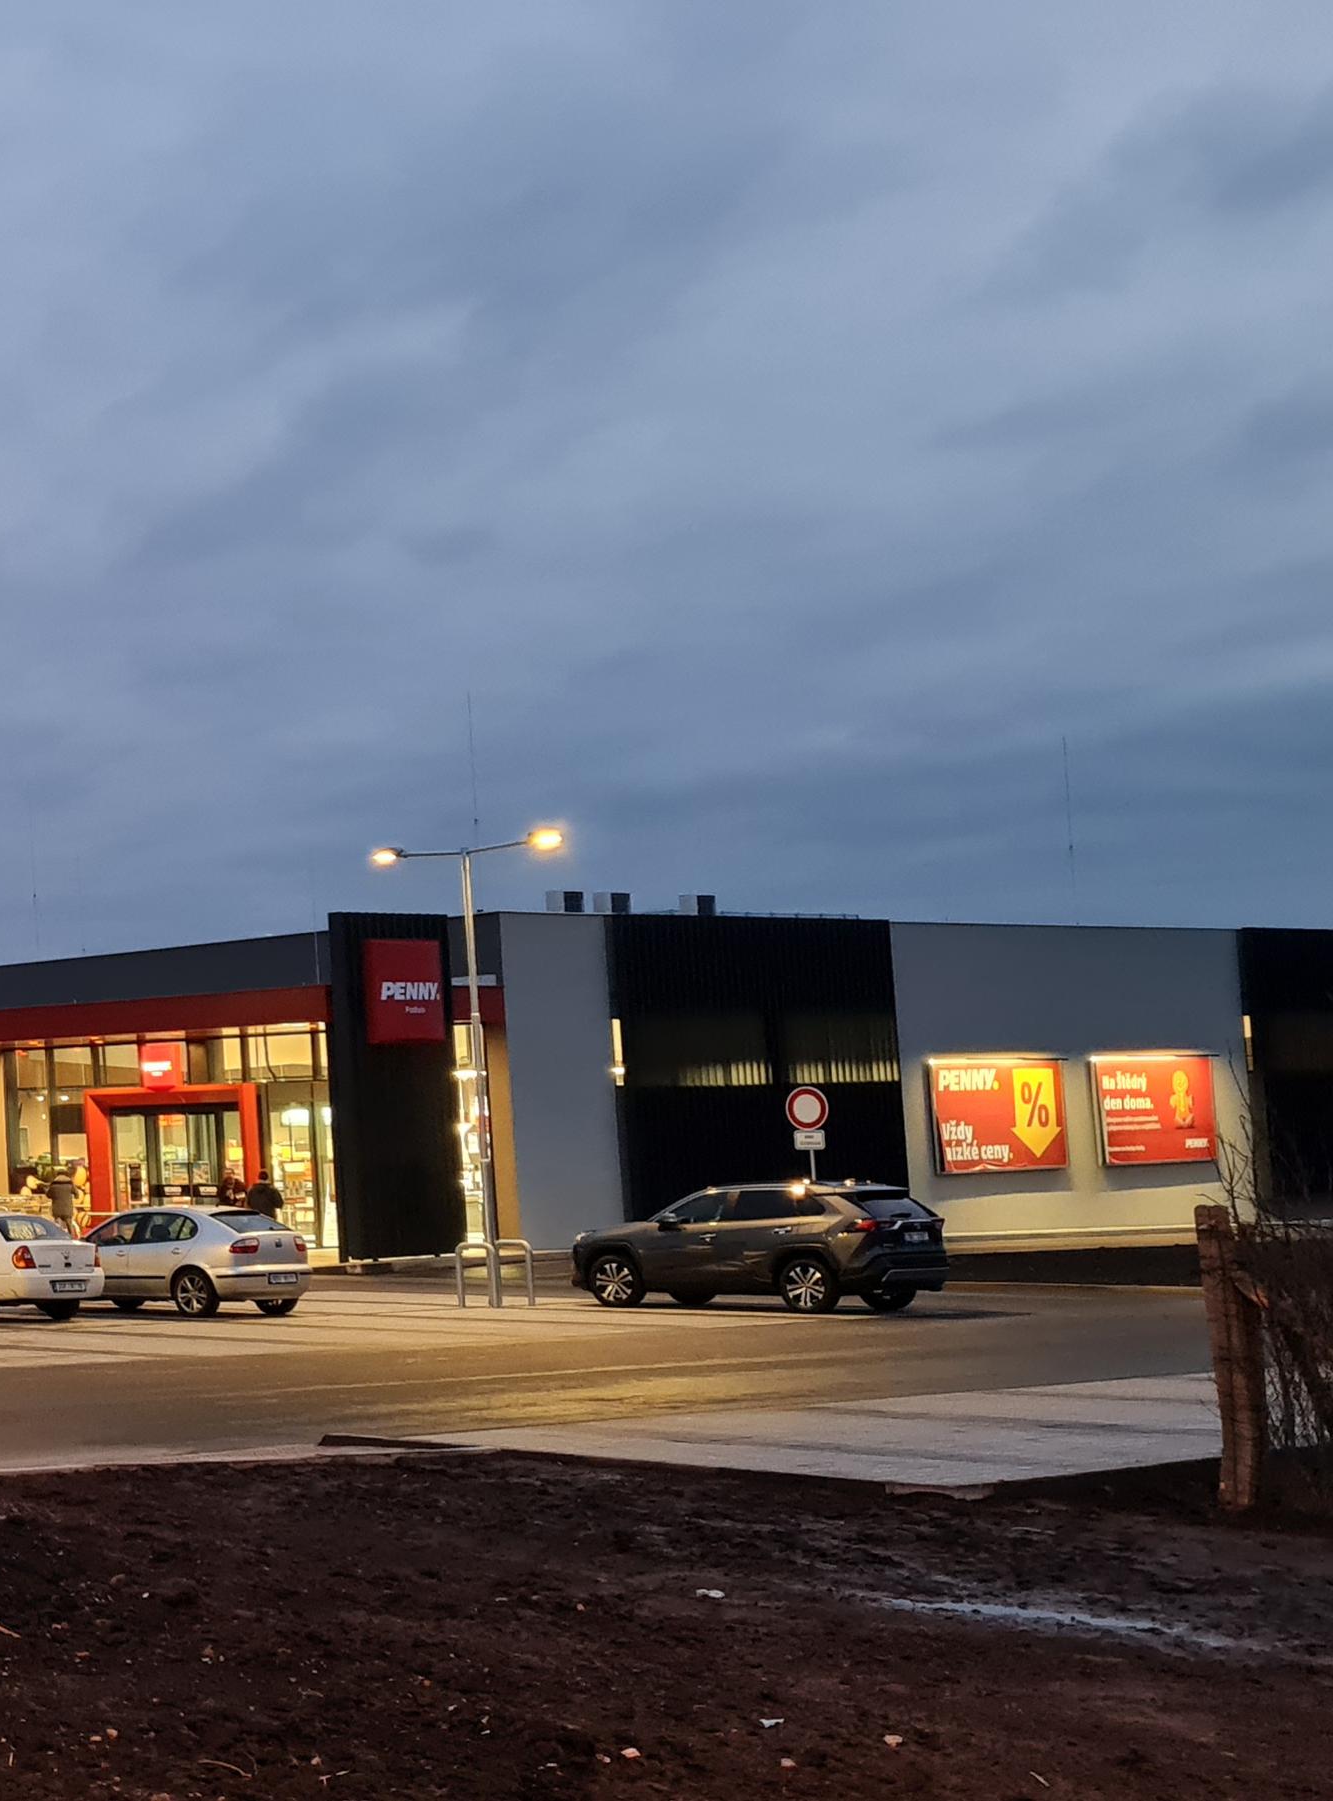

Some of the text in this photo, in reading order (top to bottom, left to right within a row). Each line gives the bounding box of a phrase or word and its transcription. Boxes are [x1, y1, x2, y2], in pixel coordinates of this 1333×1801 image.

[1103, 1094, 1122, 1110] den
[941, 1119, 973, 1144] Vždy
[980, 1144, 1014, 1163] ceny.
